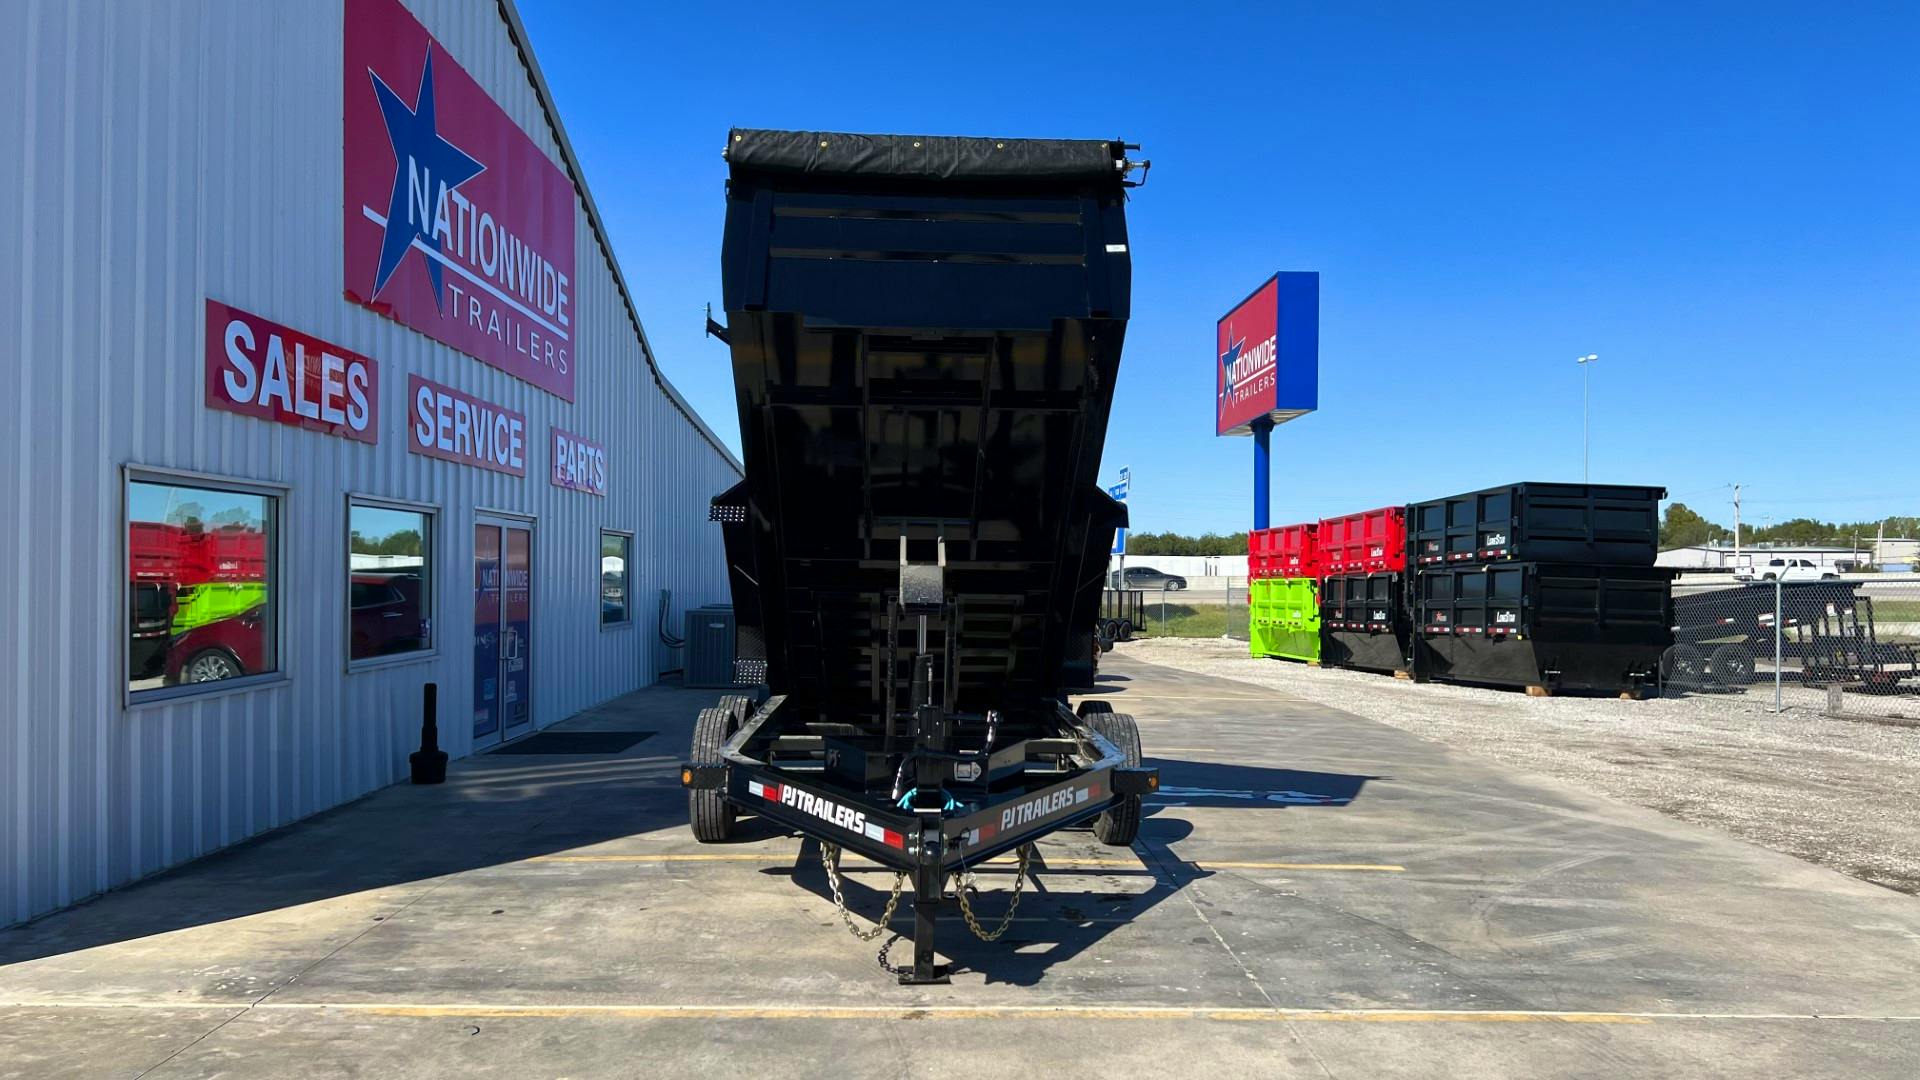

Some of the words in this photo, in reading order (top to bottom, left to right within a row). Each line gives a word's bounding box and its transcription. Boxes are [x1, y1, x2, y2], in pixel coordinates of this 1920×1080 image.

[408, 154, 569, 327] NATIONWIDE
[447, 283, 568, 375] TRAILERS
[1226, 334, 1277, 387] NATIONWIDE
[223, 319, 369, 432] SALES
[1234, 372, 1276, 404] TRAILERS
[416, 385, 523, 469] SERVICE
[556, 435, 604, 490] PARTS
